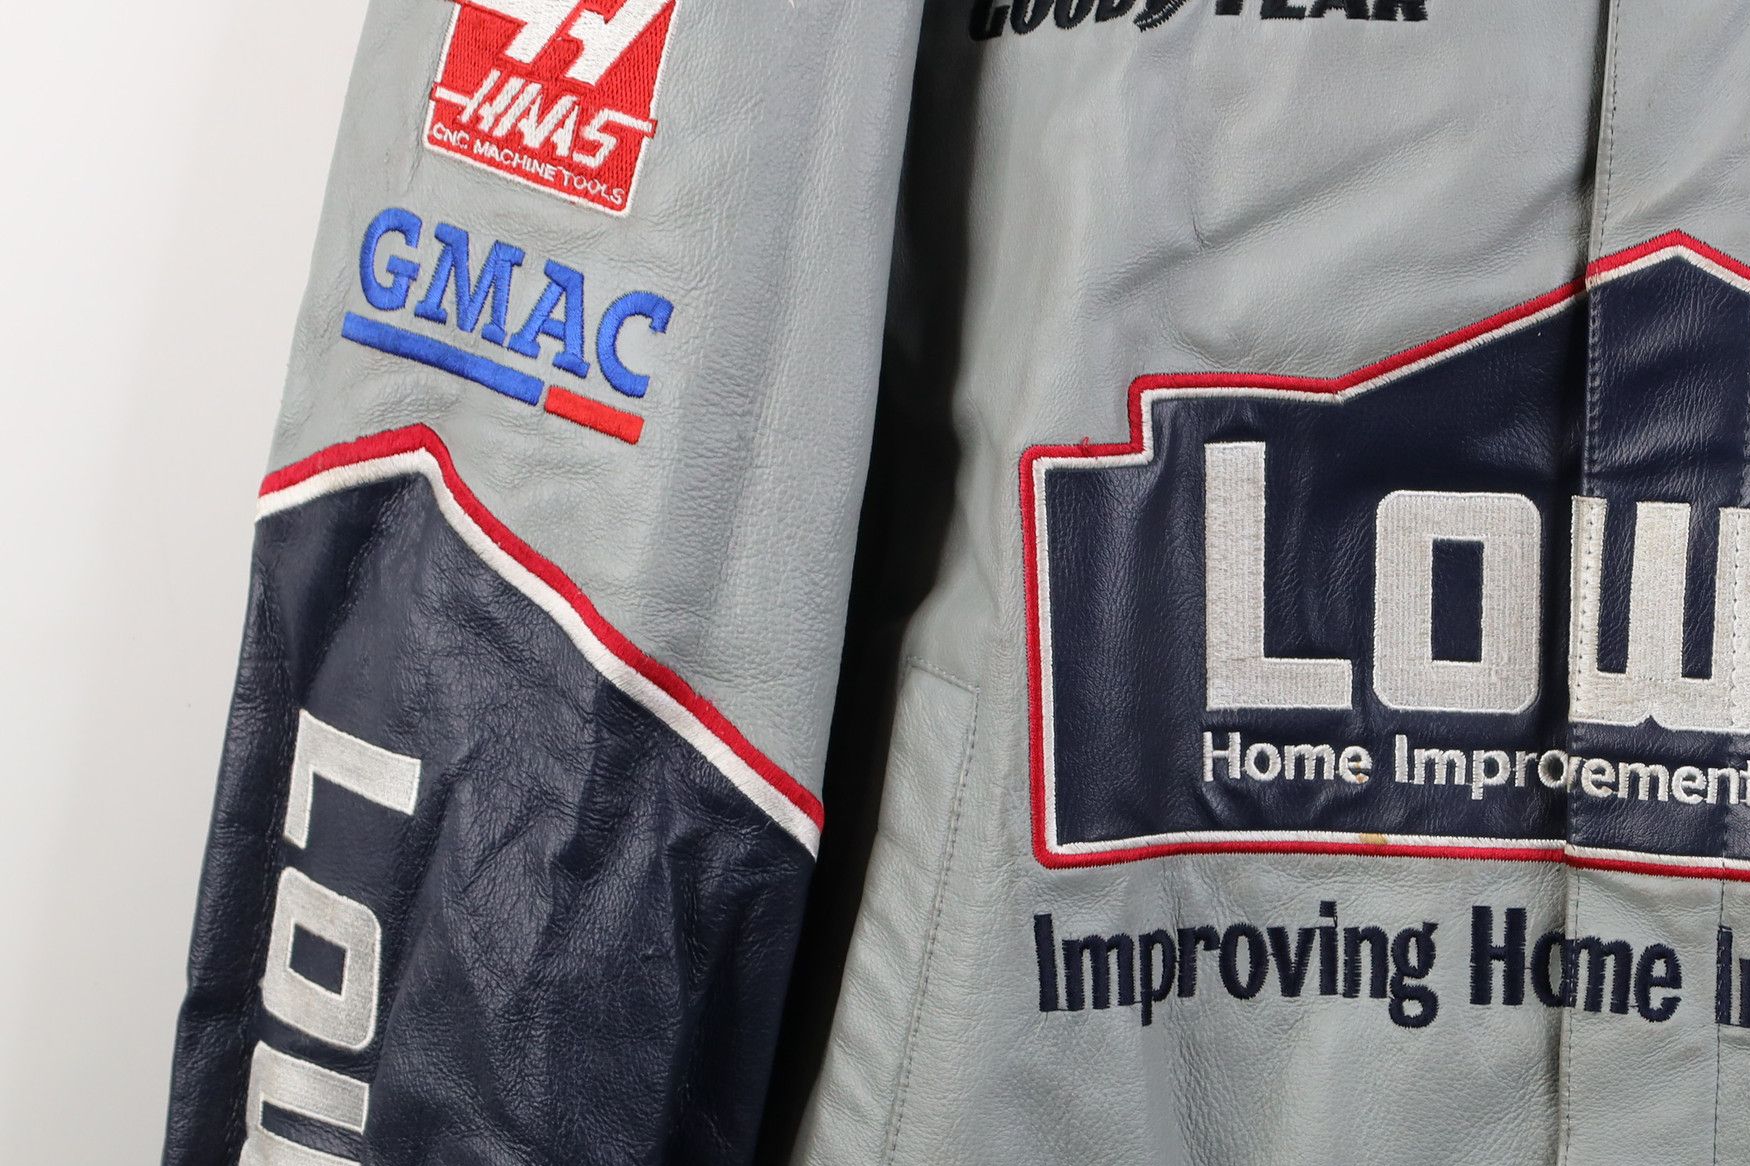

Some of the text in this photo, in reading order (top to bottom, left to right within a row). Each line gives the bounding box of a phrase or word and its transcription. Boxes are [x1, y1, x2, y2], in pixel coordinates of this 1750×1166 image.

[431, 122, 625, 205] CNC MACHINE TOOLS
[434, 68, 655, 169] HAAS
[359, 207, 675, 399] GMAC
[1202, 731, 1374, 784] Home
[1033, 901, 1440, 1029] Improving
[1470, 905, 1683, 1023] Home
